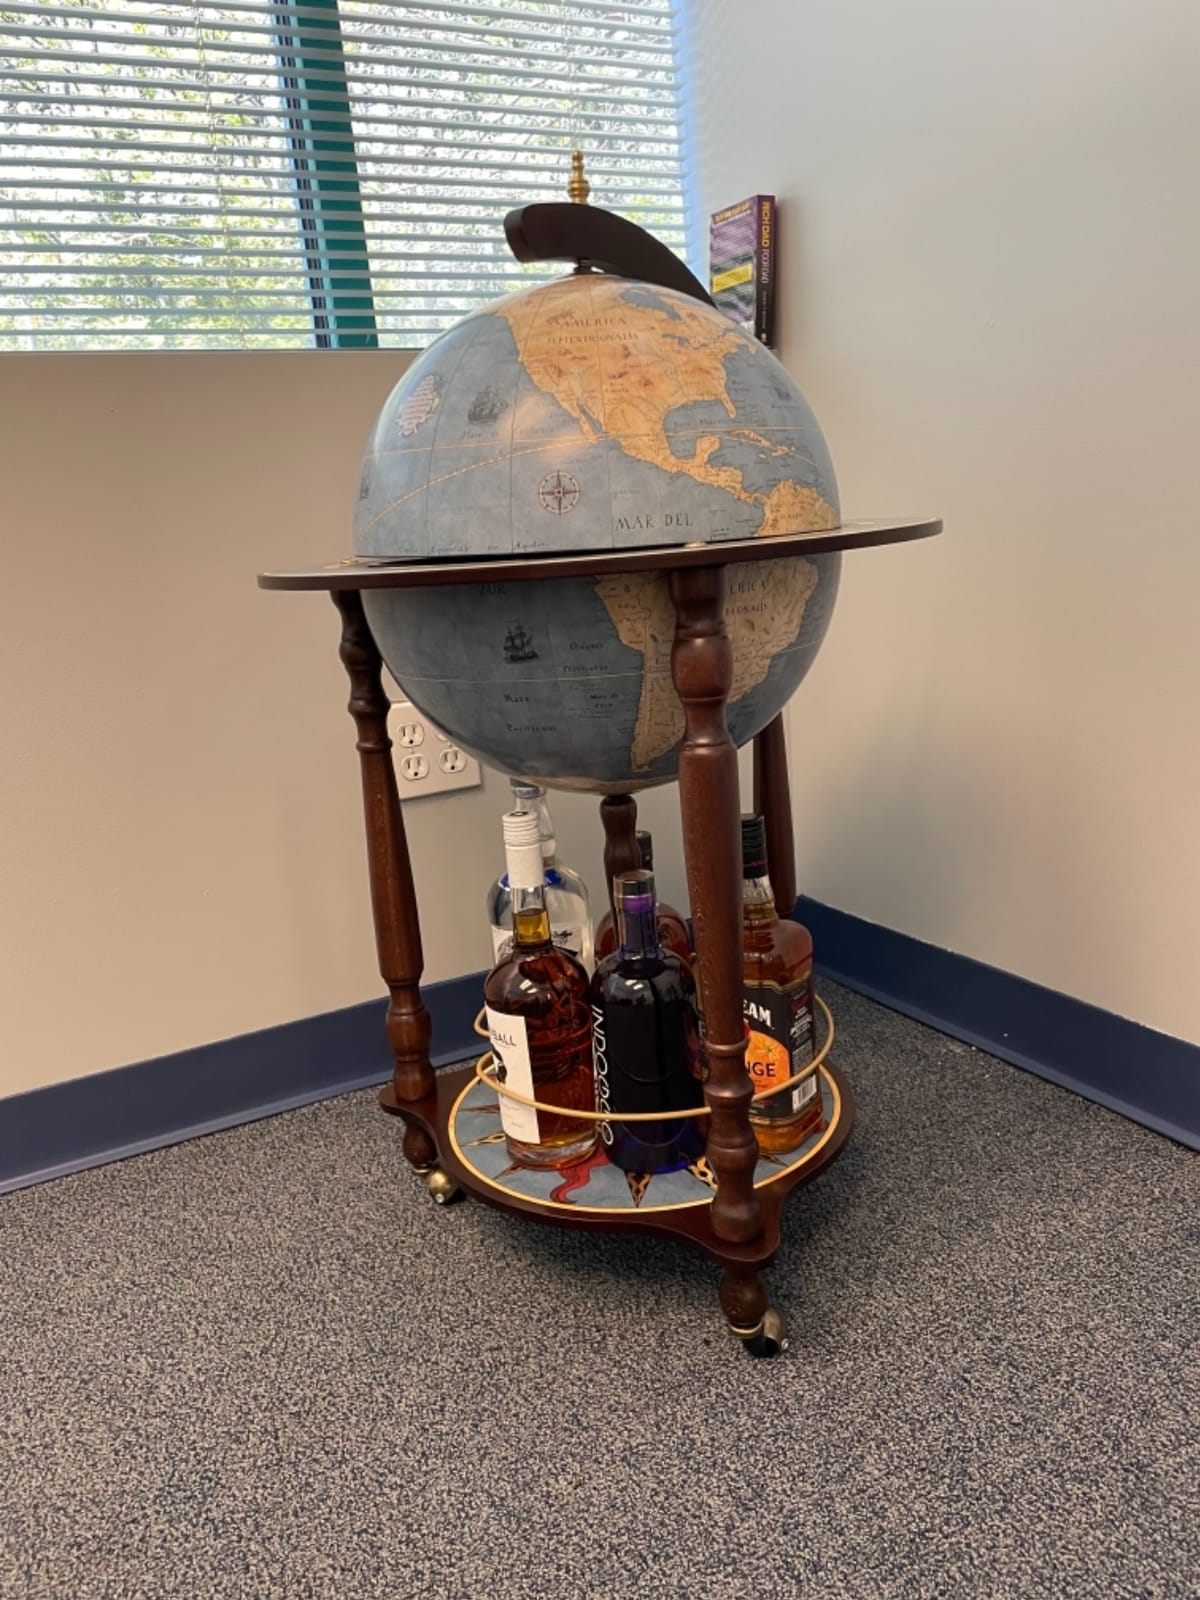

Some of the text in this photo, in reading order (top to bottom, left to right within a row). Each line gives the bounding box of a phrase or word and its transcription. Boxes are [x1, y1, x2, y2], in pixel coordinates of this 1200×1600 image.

[762, 226, 770, 248] DAD
[616, 514, 655, 531] MAR
[664, 513, 694, 527] DEL
[480, 583, 508, 596] ZUR
[729, 578, 768, 595] ERICA
[743, 999, 772, 1027] EAM
[491, 1028, 518, 1047] BALL
